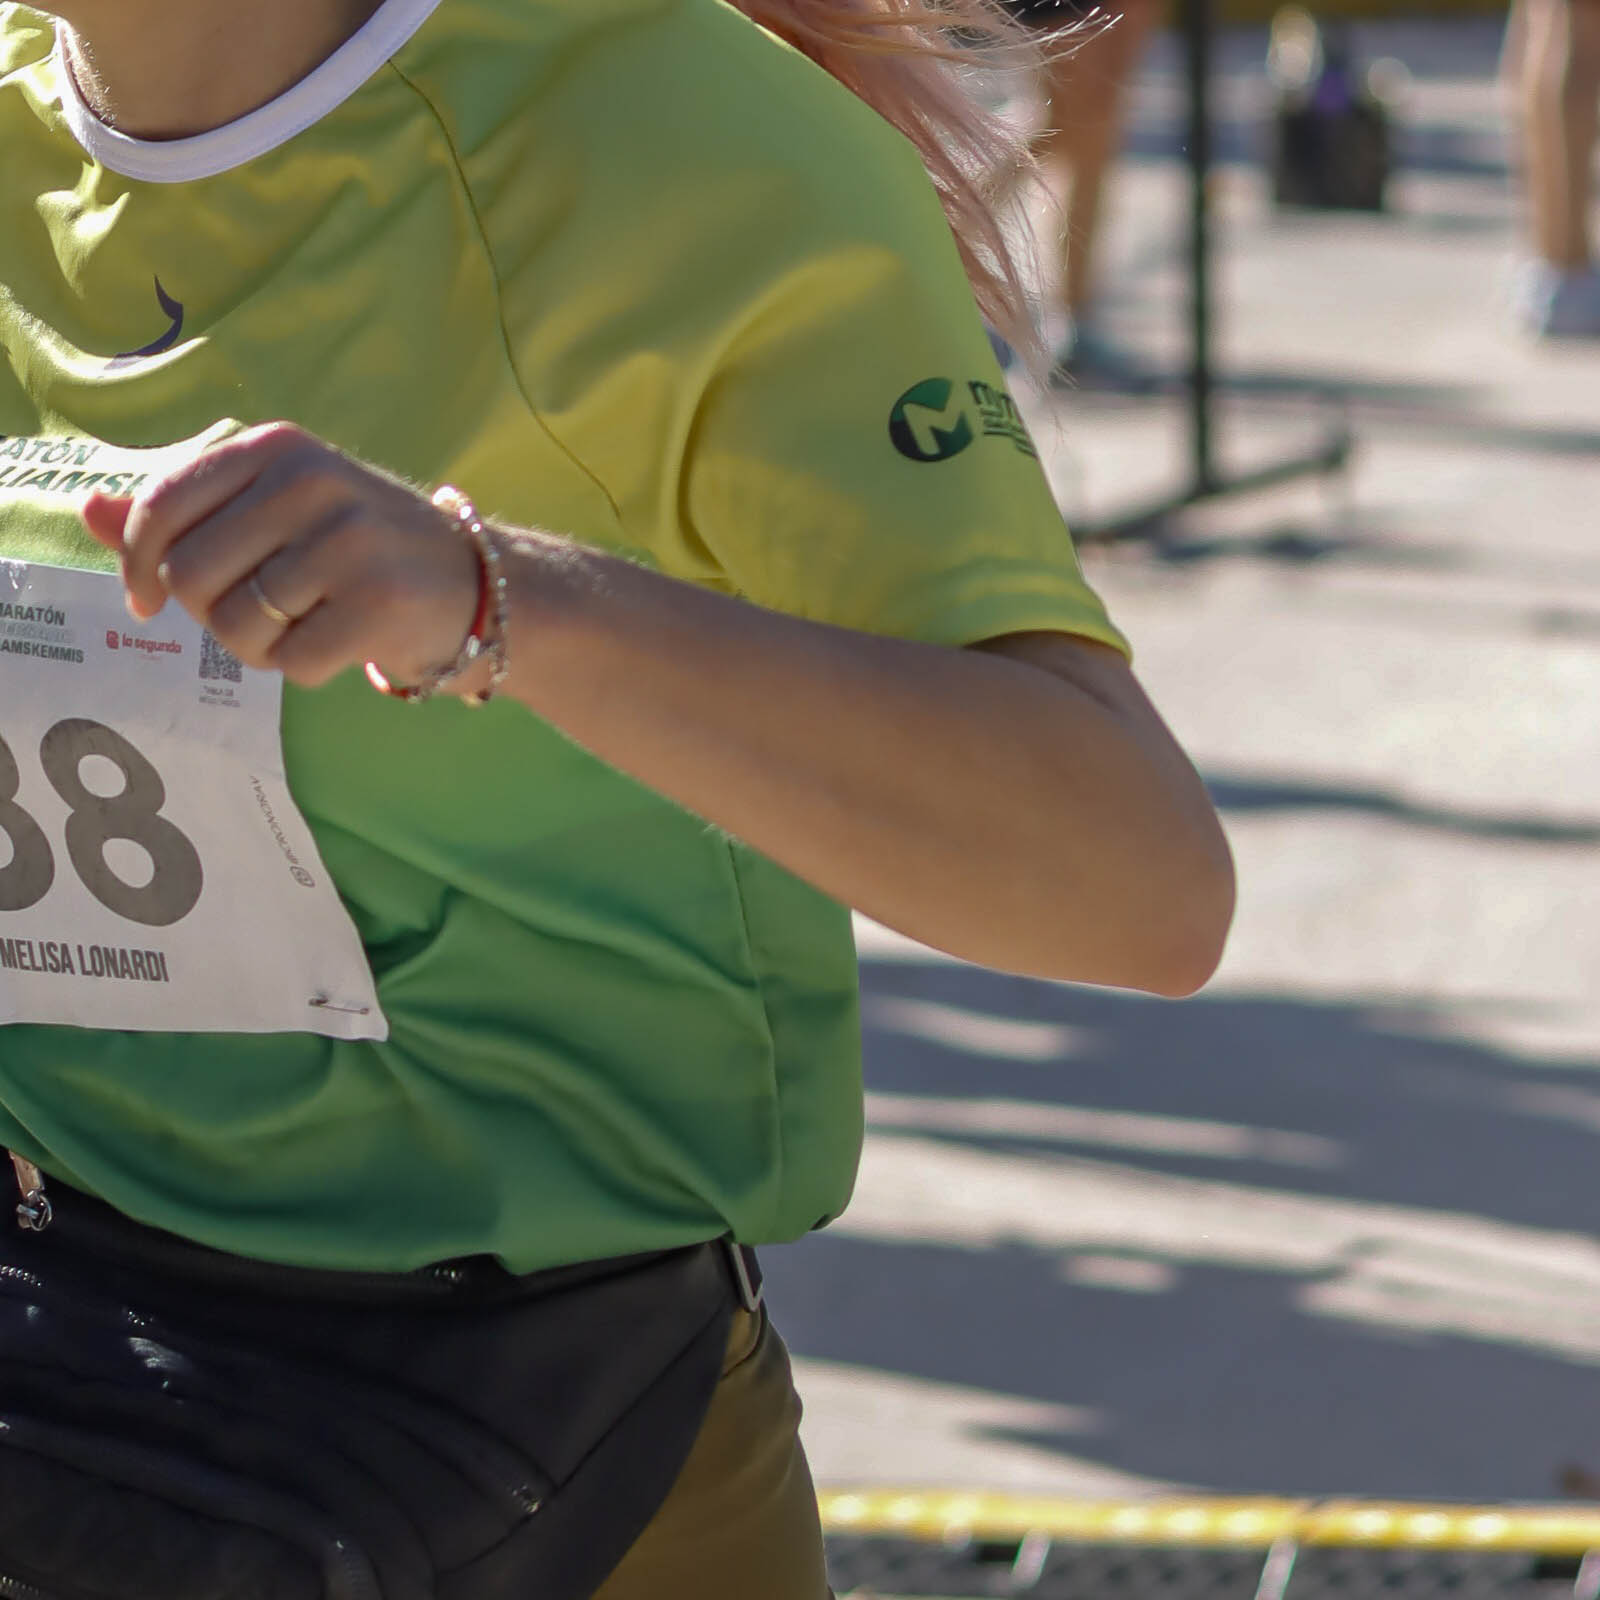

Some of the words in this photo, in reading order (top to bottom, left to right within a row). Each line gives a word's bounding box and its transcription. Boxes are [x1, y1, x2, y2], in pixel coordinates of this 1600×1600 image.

[122, 632, 133, 648] la
[135, 637, 182, 654] segunda
[77, 944, 170, 983] LONARDI
